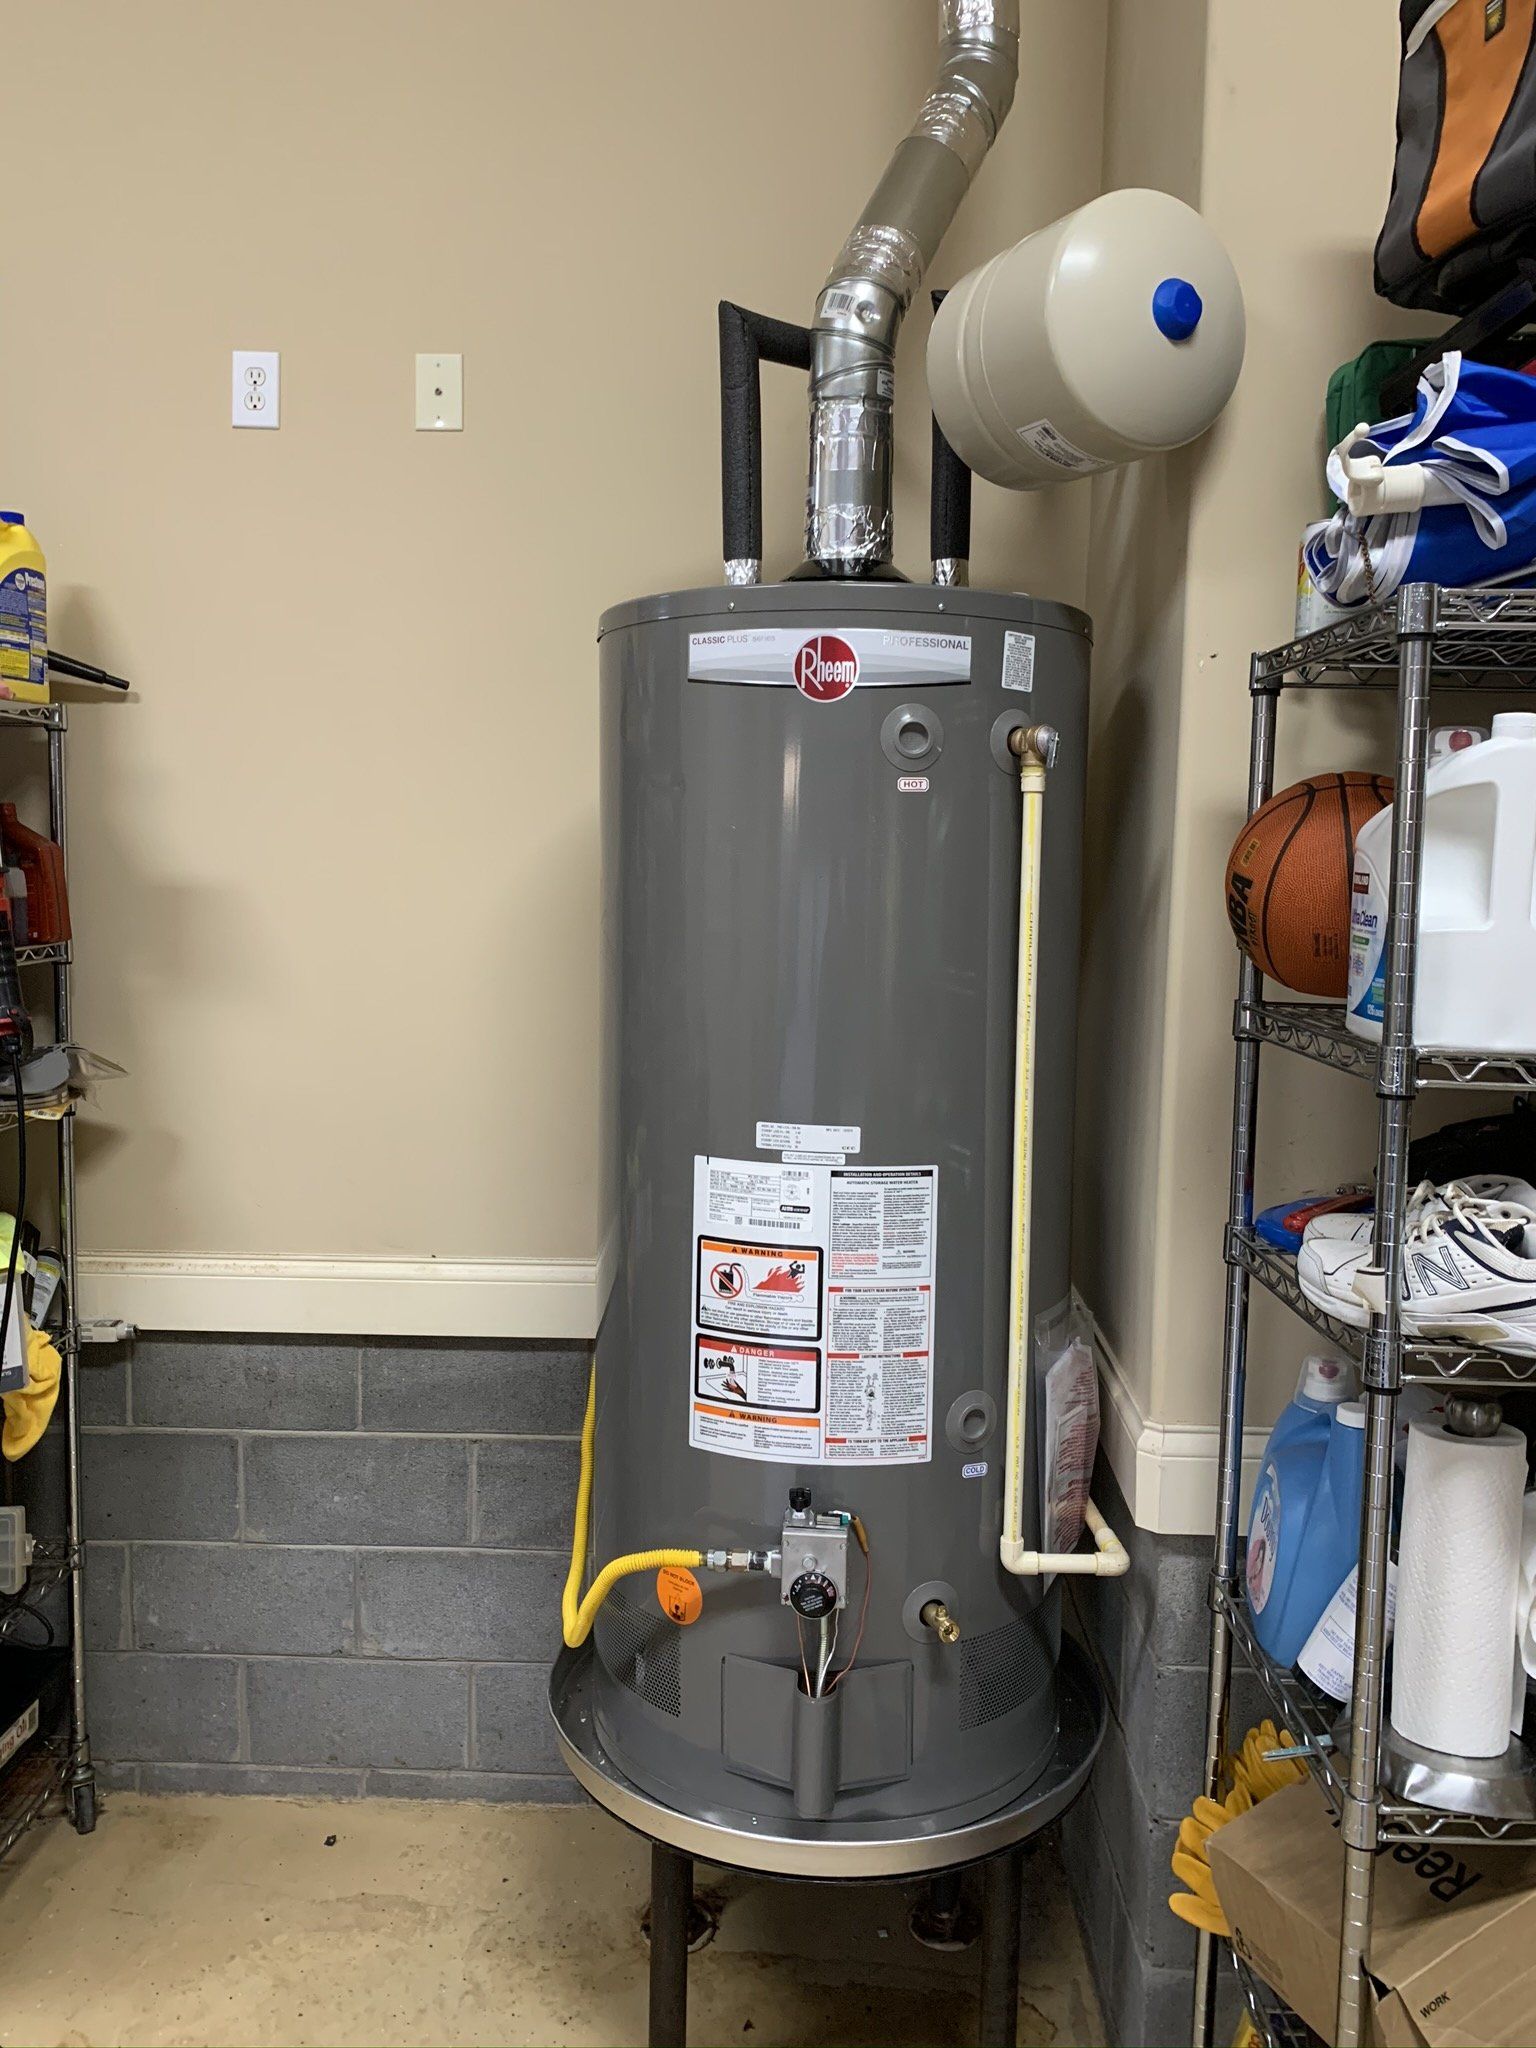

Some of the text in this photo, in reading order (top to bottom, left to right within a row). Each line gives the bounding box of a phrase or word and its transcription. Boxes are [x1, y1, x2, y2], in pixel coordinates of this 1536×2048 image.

[692, 636, 726, 645] CLASSIC
[727, 634, 748, 643] PLUS
[883, 636, 969, 650] PROFESSIONAL
[801, 636, 855, 692] Rheem
[903, 780, 924, 789] HOT
[741, 1248, 784, 1257] WARNING
[1411, 1245, 1470, 1296] N
[739, 1348, 775, 1358] DANGER
[739, 1413, 778, 1423] WARNING
[965, 1465, 985, 1475] COLD
[1419, 1990, 1451, 2019] WORK
